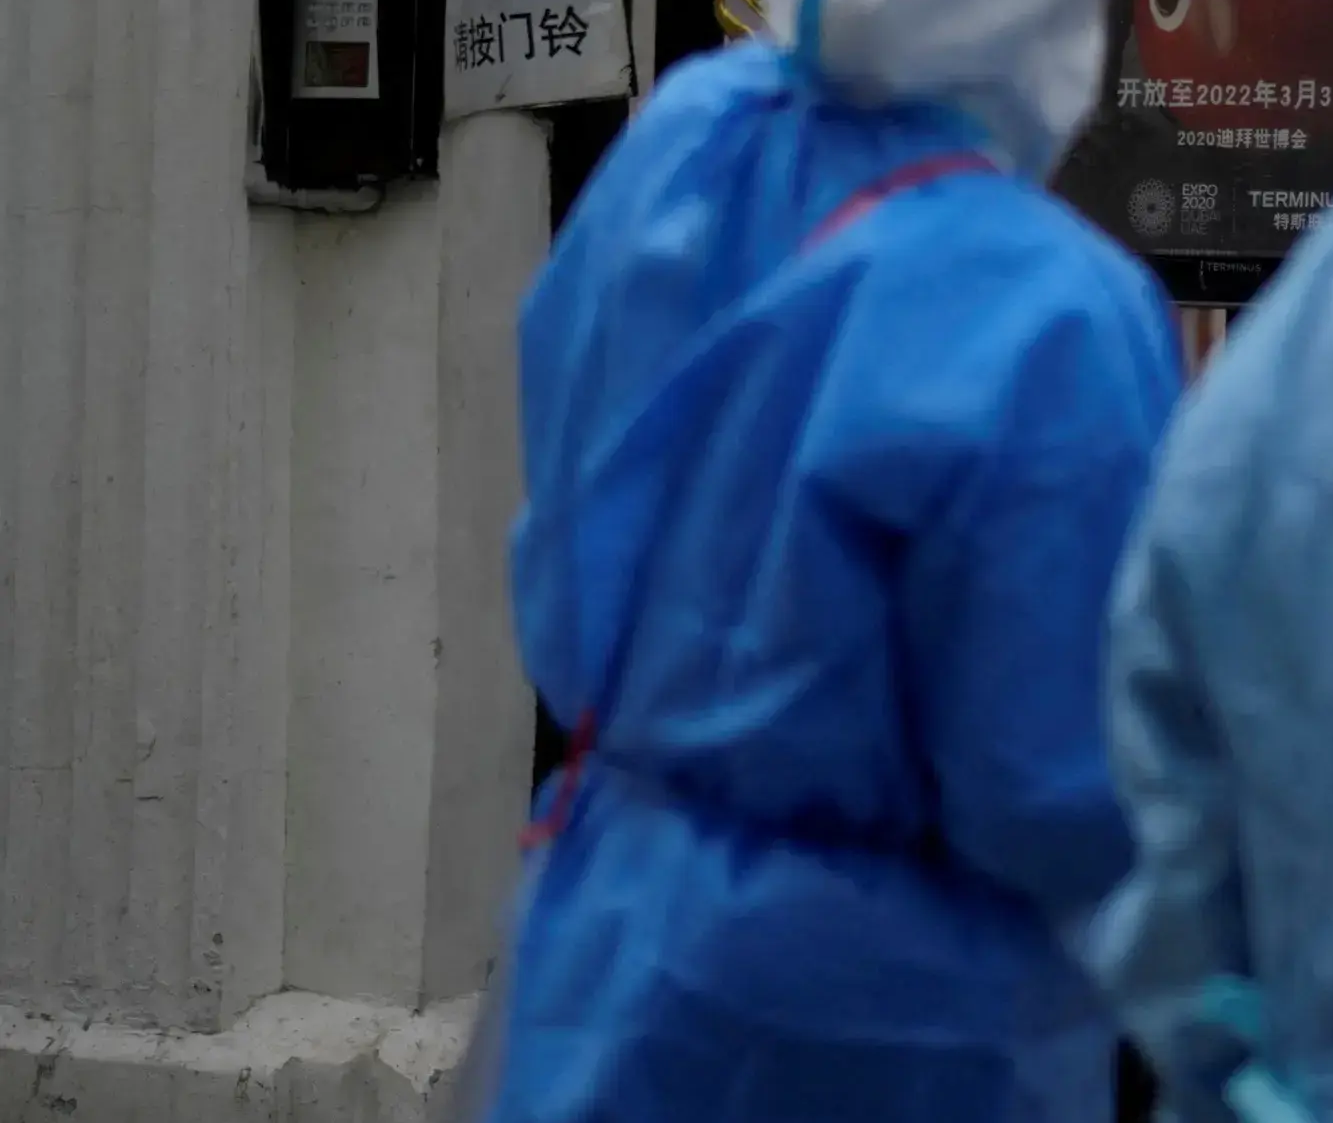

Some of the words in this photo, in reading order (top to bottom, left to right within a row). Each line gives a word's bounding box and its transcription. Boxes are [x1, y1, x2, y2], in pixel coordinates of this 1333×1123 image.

[453, 5, 589, 72] 请按门铃
[1177, 128, 1308, 150] 2020迪拜世博会
[1181, 182, 1219, 197] EXPO
[1181, 196, 1216, 210] 2020
[1206, 261, 1262, 273] TERMINUS
